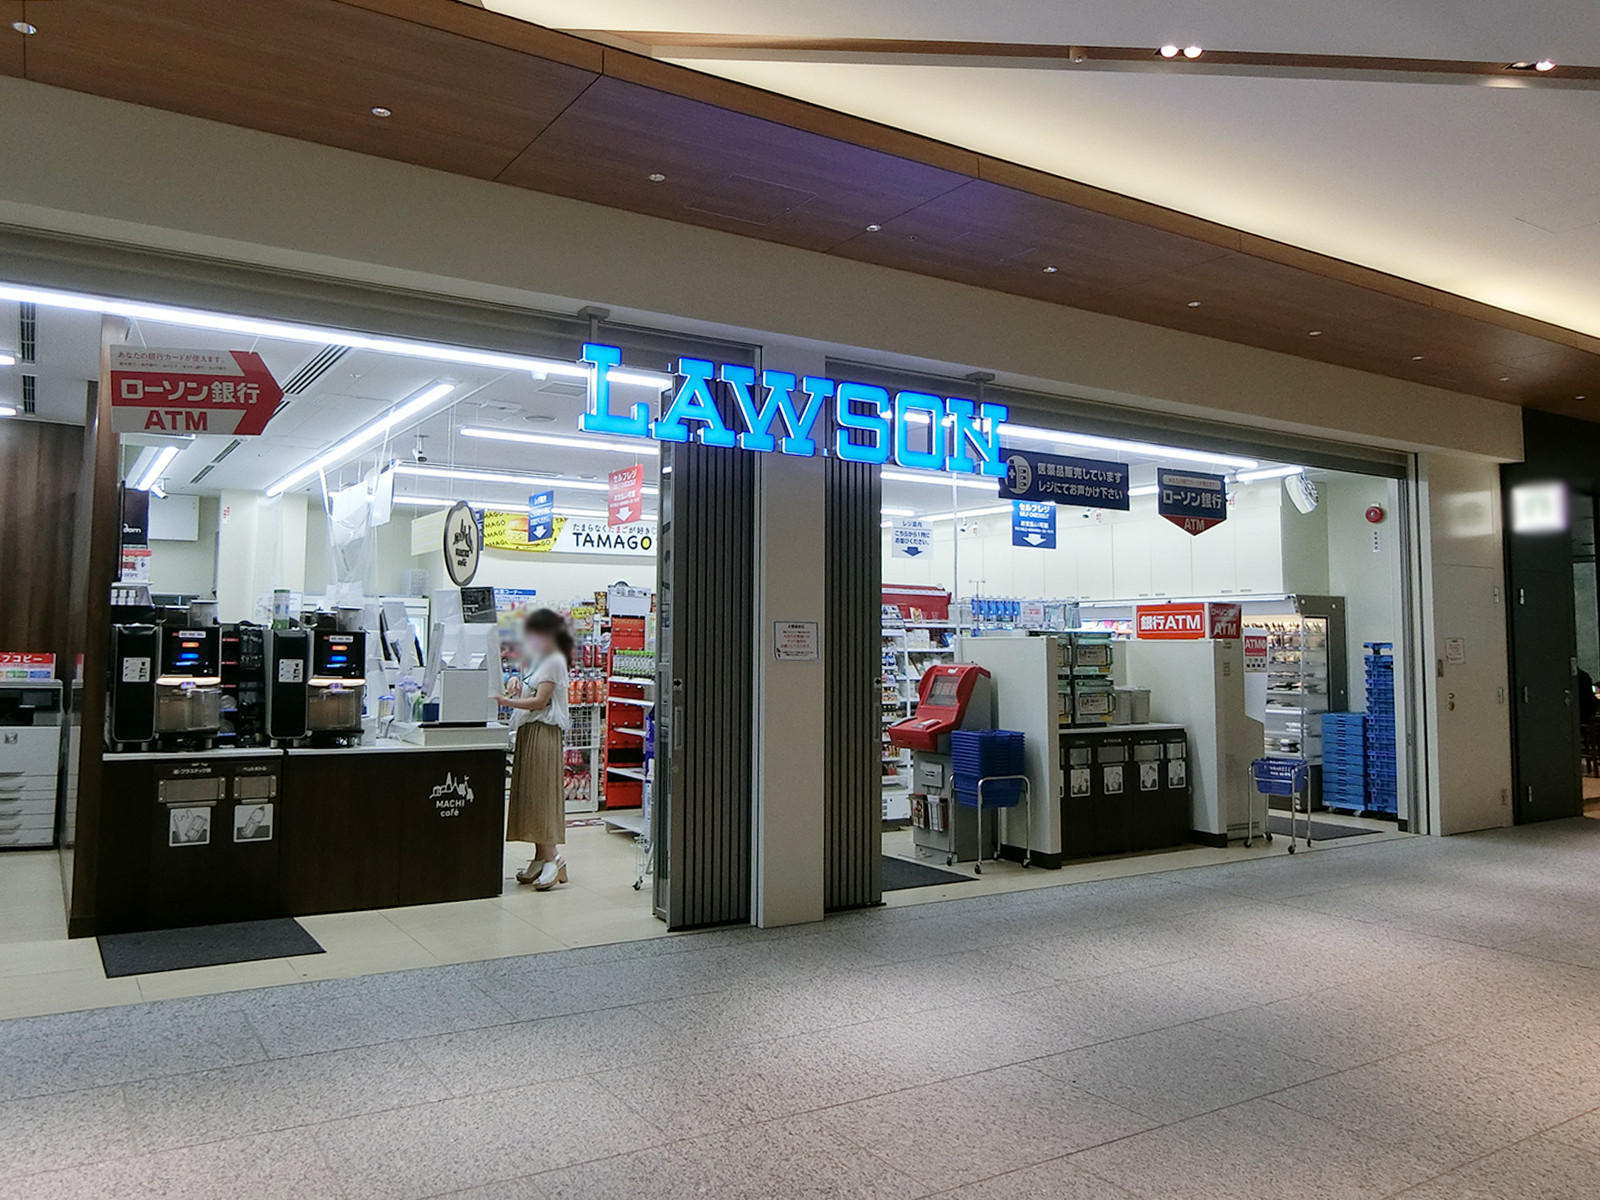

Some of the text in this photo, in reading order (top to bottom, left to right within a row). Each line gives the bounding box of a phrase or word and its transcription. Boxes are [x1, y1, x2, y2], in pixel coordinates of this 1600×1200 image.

[120, 378, 261, 404] ローソン銀行
[144, 409, 208, 431] ATM
[577, 342, 1010, 479] LAWSON
[1037, 462, 1123, 483] 医薬品販売しています
[1038, 480, 1123, 500] レジにてお声かけ下さい
[1163, 489, 1222, 509] ローソン銀行
[1184, 518, 1205, 531] ATM
[572, 532, 652, 550] TAMAGO
[1140, 614, 1201, 631] 銀行ATM
[1213, 622, 1237, 635] ATM
[0, 654, 44, 663] フコピー
[435, 799, 466, 809] MACHI
